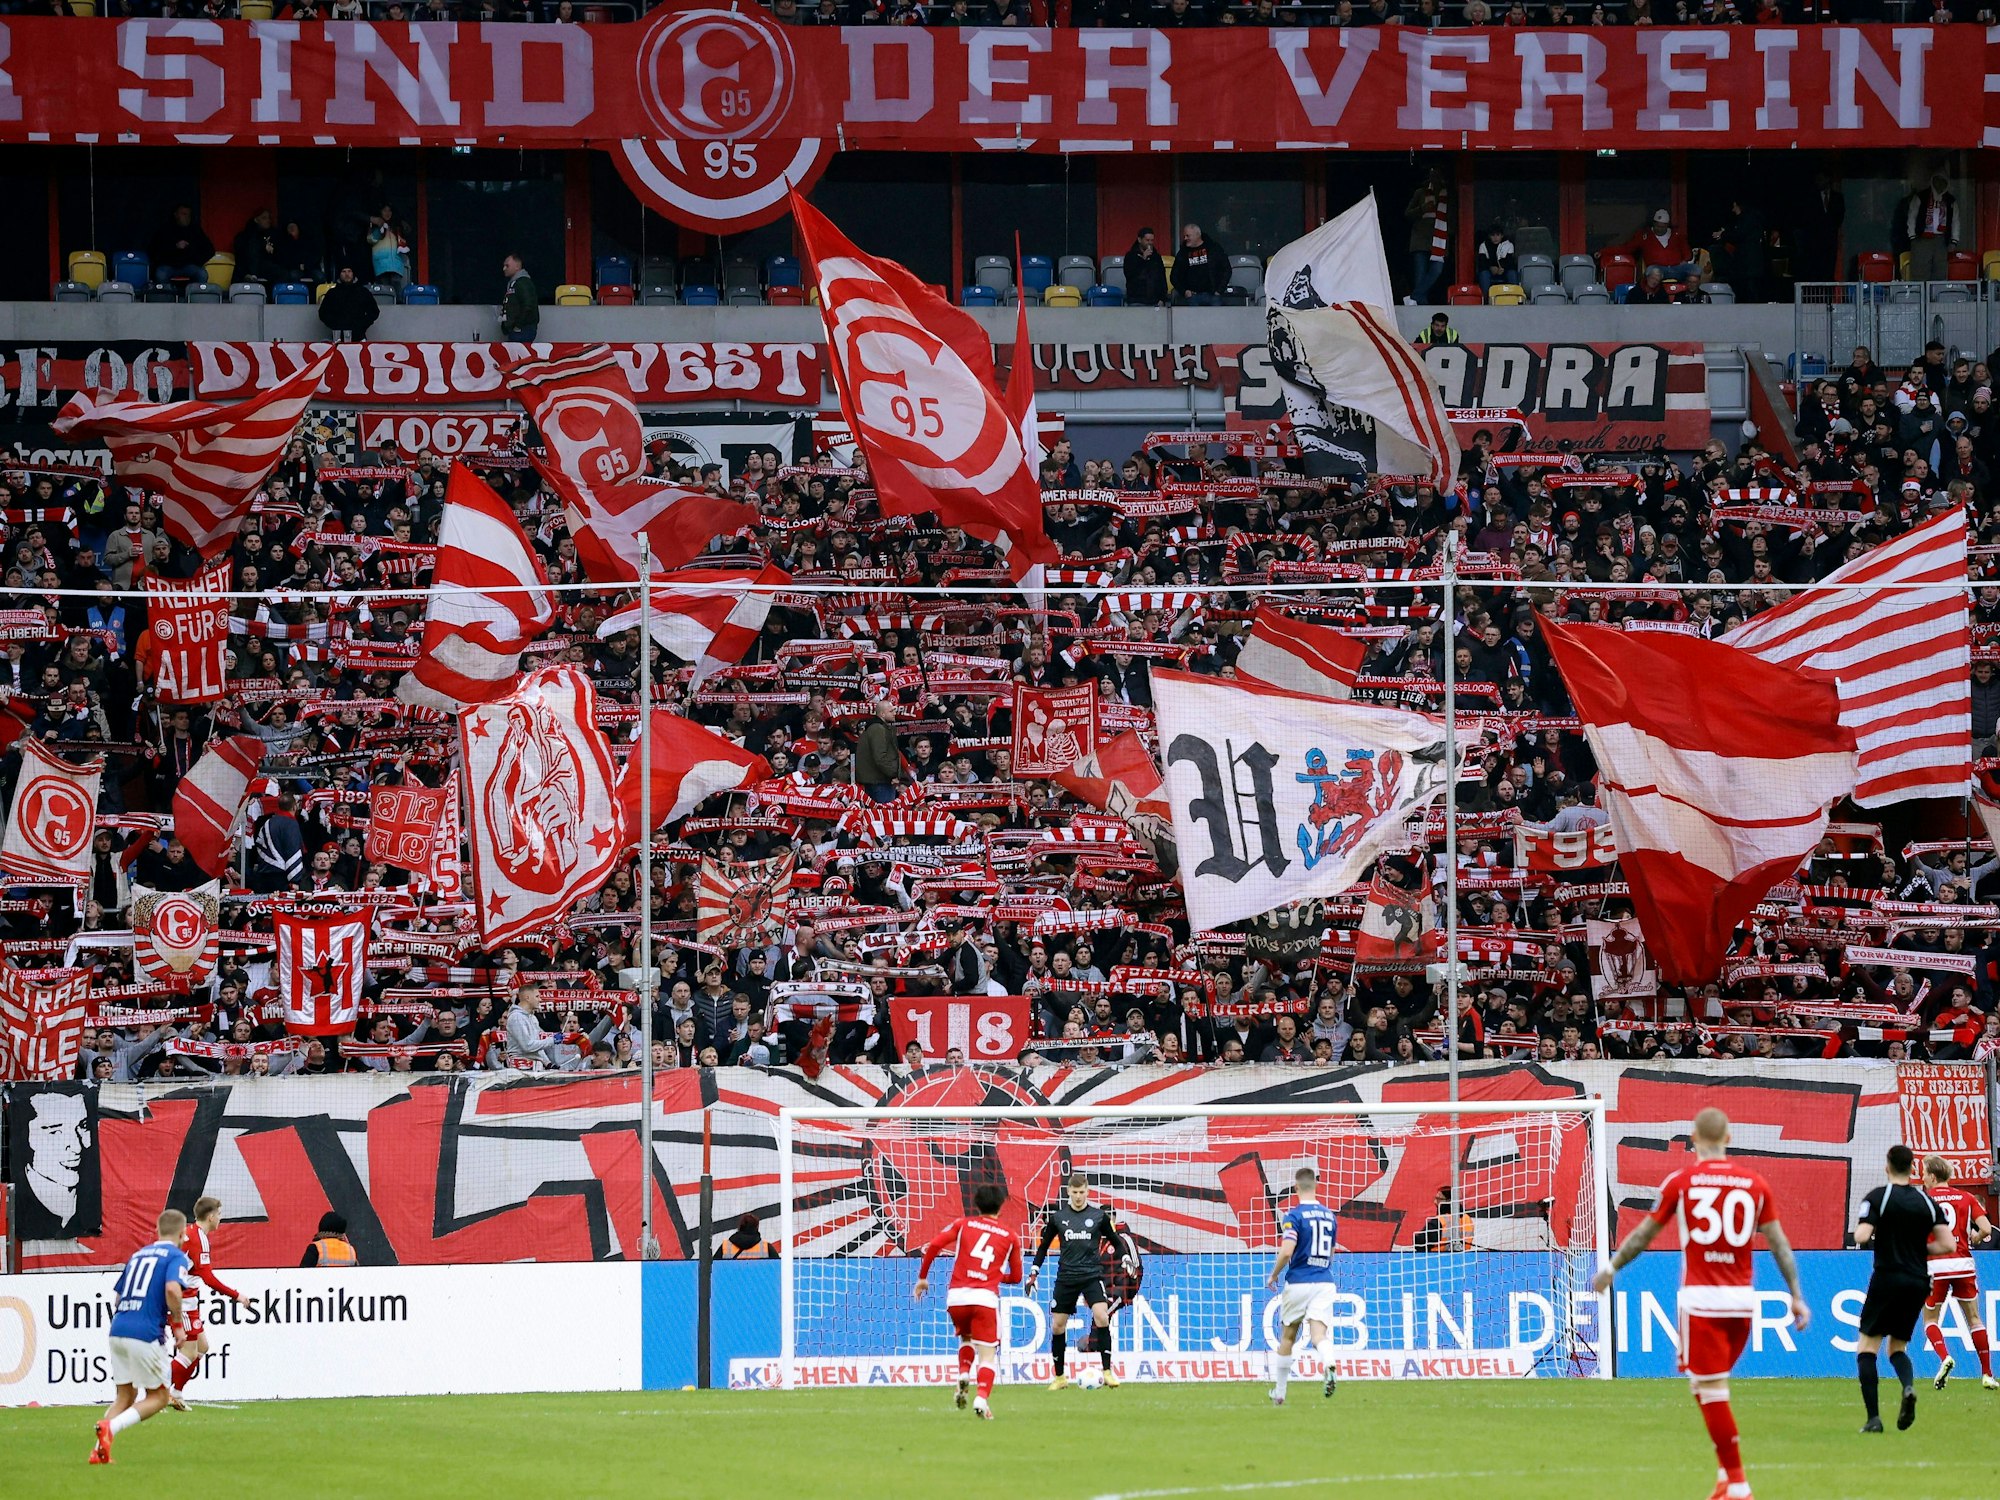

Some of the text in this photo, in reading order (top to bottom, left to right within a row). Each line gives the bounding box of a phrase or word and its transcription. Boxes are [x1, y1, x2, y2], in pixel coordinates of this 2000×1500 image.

[116, 18, 594, 127] SIND
[840, 26, 1934, 131] DER VEREIN
[703, 142, 757, 179] 95
[890, 395, 944, 439] 95
[1169, 433, 1243, 442] FORTUNA 1895
[1618, 433, 1667, 451] 2008
[598, 447, 630, 482] 95
[350, 469, 374, 478] NEVER
[1041, 490, 1067, 502] MMER
[1775, 508, 1845, 520] FORTUNA
[316, 533, 355, 543] FORTUNA
[146, 564, 232, 608] FREIHEIT
[1565, 592, 1580, 600] DIE
[175, 610, 215, 645] FÜR
[820, 680, 844, 688] WIEDER
[908, 671, 950, 683] LEEN
[1352, 688, 1375, 700] LLES
[1377, 690, 1399, 701] AUS
[624, 712, 641, 721] AM
[826, 702, 858, 717] IMMER
[1068, 707, 1090, 716] LIEBE
[1107, 706, 1132, 715] 1895
[1078, 715, 1090, 725] DIR
[957, 737, 990, 749] IMMER
[758, 792, 788, 805] FORTUNA
[685, 819, 721, 831] IMMER
[53, 829, 71, 846] 95
[995, 864, 1014, 872] MEINE
[367, 893, 396, 904] 1895
[1875, 901, 1919, 911] FORTUNA
[181, 927, 193, 939] 95
[4, 940, 39, 952] IMMER
[1917, 954, 1973, 969] FORTUNA
[1066, 979, 1138, 994] ULTRAS
[557, 990, 621, 1000] LEBEN LANG
[261, 1005, 284, 1019] IMME
[1212, 1001, 1285, 1016] ULTRAS
[1904, 1079, 1925, 1094] IST
[1900, 1094, 1986, 1151] KRAFT
[1687, 1187, 1756, 1247] 30
[1309, 1219, 1333, 1257] 16
[970, 1232, 996, 1271] 4
[122, 1256, 159, 1298] 10
[48, 1288, 408, 1329] Univtätsklinikum
[1404, 1291, 1474, 1350] IN
[1136, 1359, 1258, 1379] AKTUELL
[1401, 1357, 1524, 1378] AKTUELL
